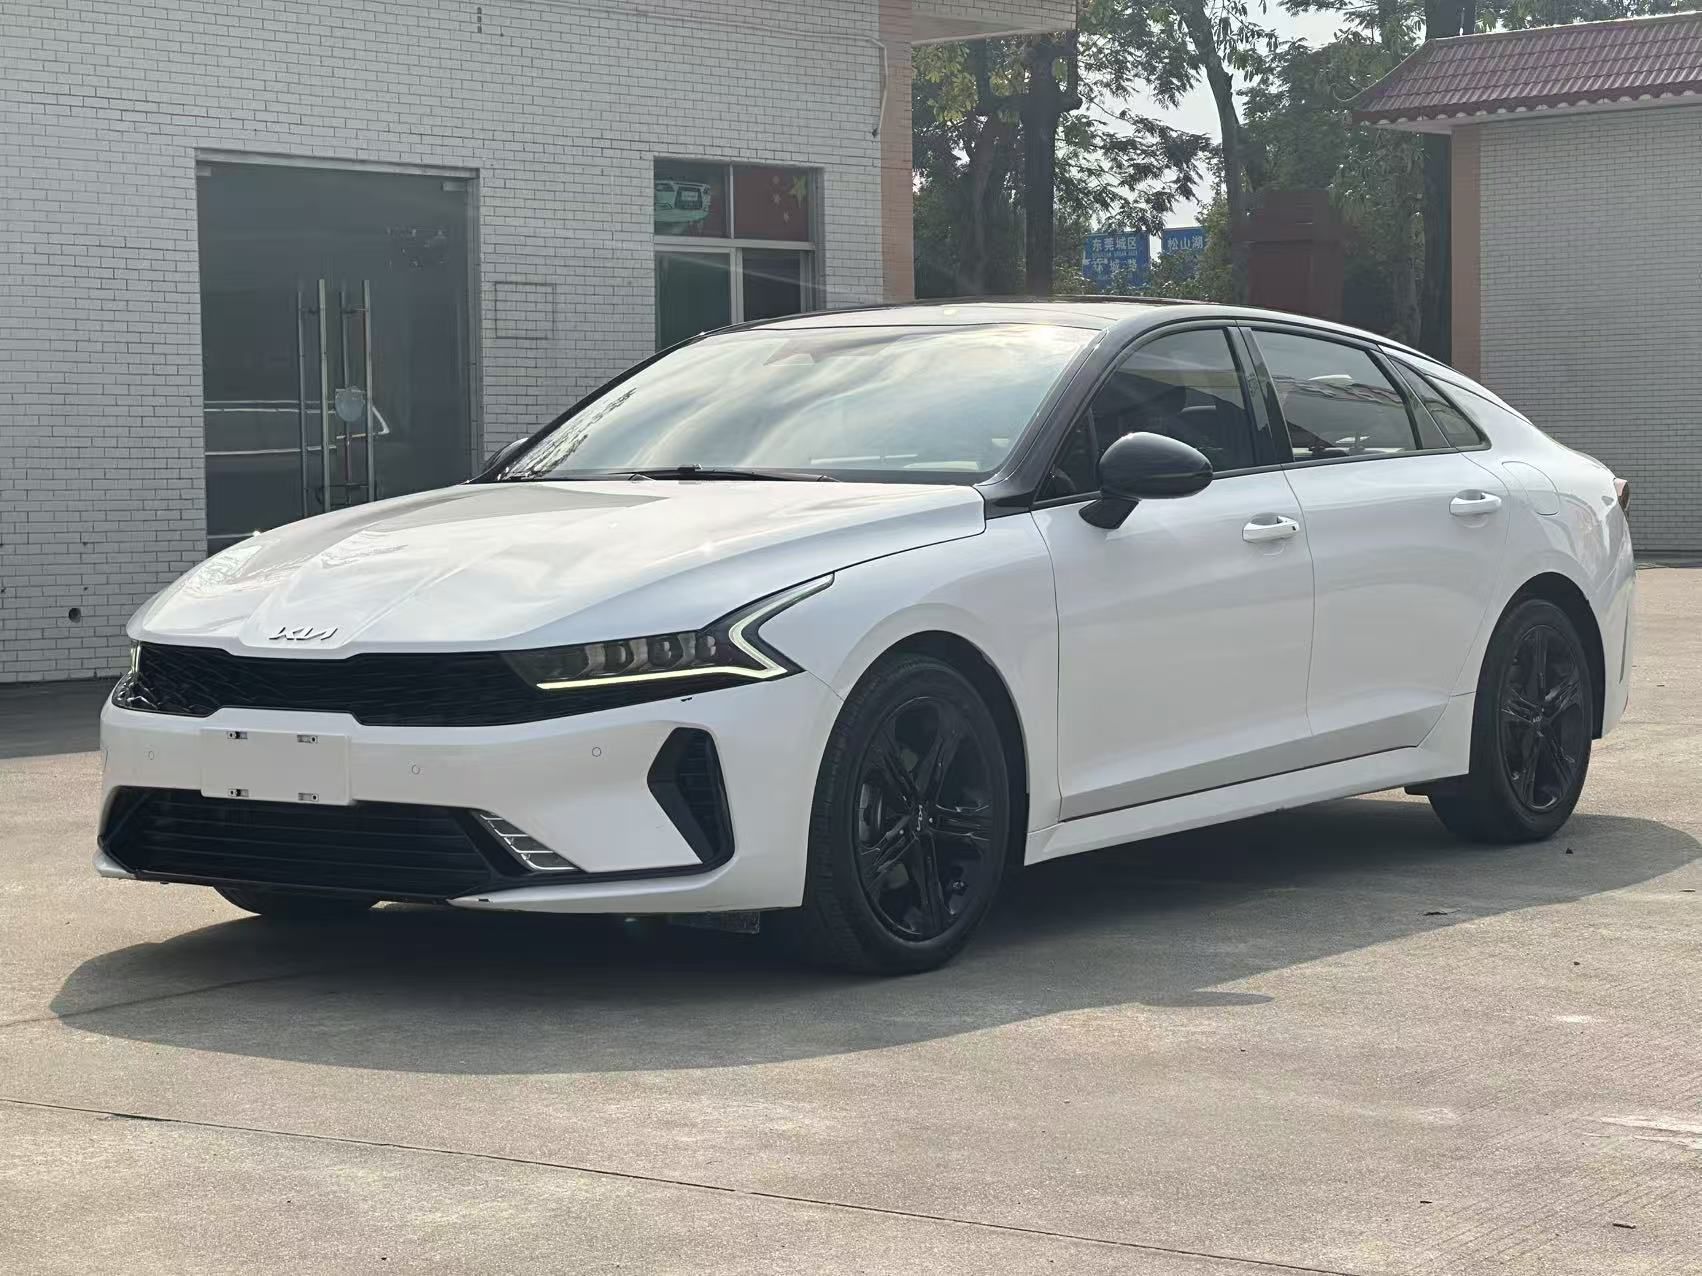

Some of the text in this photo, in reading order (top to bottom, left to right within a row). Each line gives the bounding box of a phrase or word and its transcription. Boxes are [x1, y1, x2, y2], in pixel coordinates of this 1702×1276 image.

[1092, 236, 1137, 251] 东莞城区
[267, 625, 339, 642] KIA
